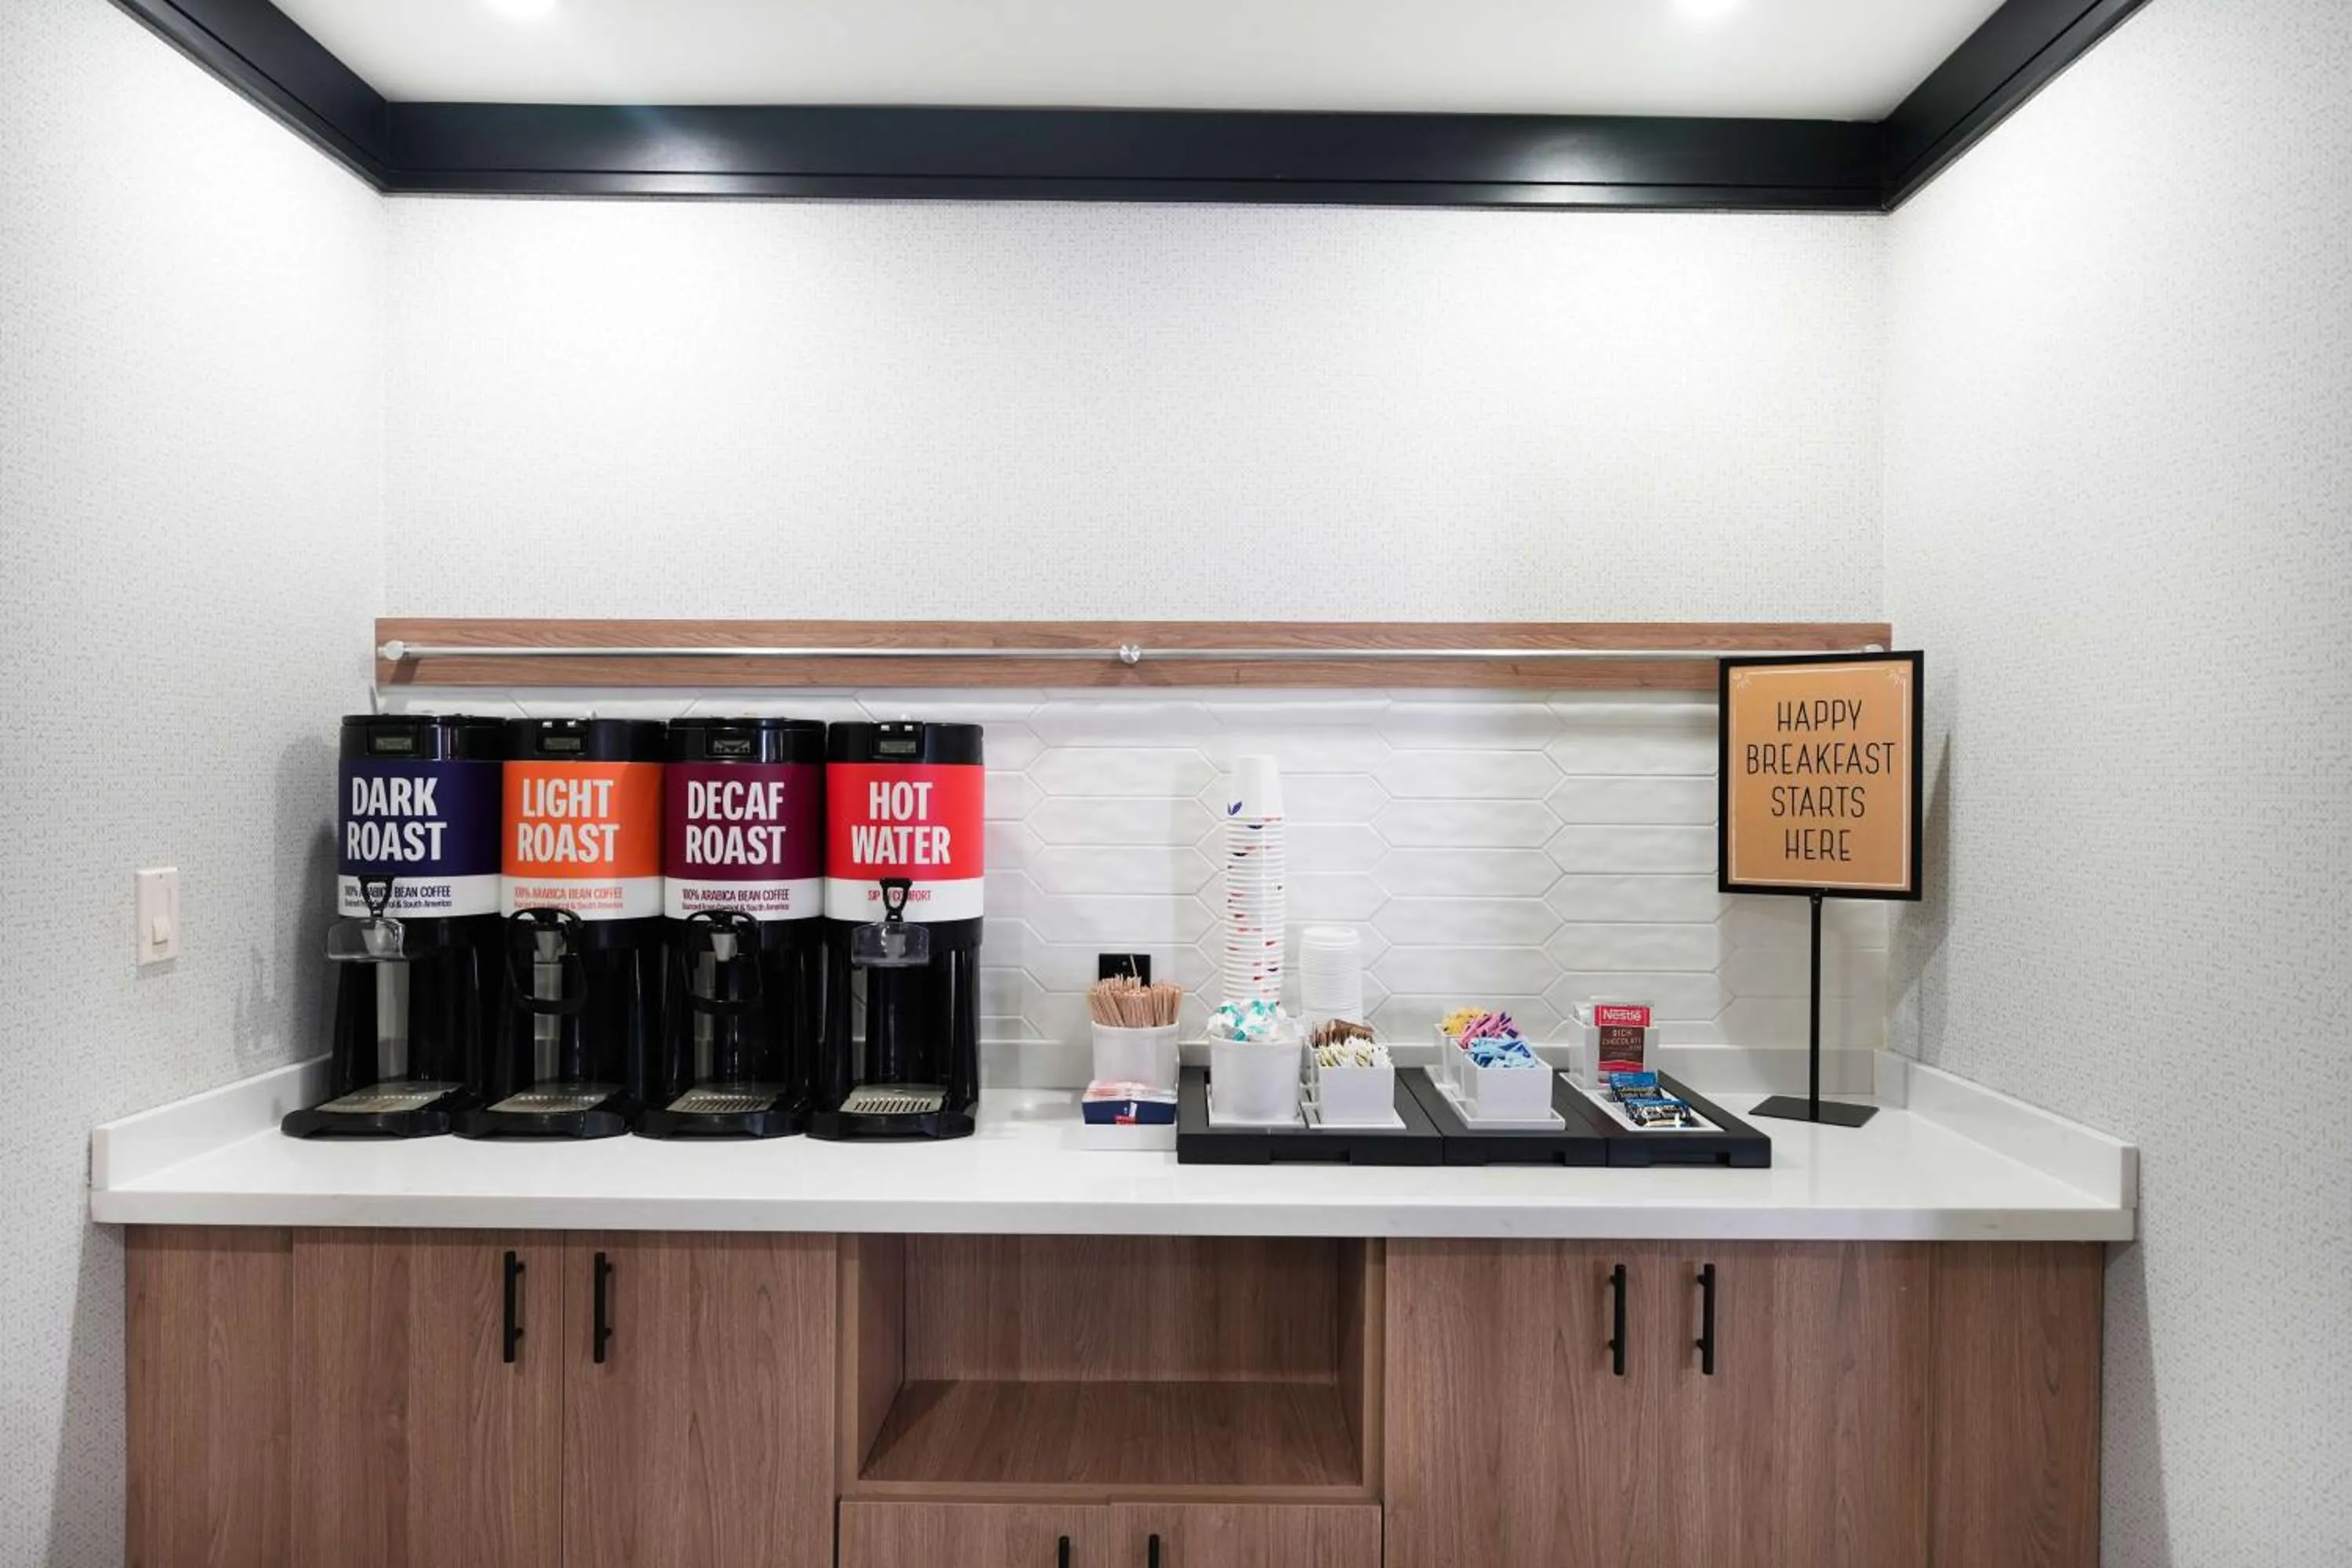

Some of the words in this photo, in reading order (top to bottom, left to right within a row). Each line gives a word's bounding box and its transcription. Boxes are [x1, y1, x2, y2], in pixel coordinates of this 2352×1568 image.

[1777, 699, 1863, 731] HAPPY
[1746, 742, 1896, 775] BREAKFAST
[351, 777, 438, 816] DARK
[522, 778, 614, 818] LIGHT
[688, 780, 785, 821] DECAF
[869, 780, 933, 821] HOT
[1771, 786, 1866, 818] STARTS
[347, 821, 447, 862] ROAST
[517, 822, 620, 862] ROAST
[686, 825, 786, 865] ROAST
[851, 825, 951, 866] WATER
[1785, 828, 1852, 862] HERE
[394, 887, 418, 898] BEAN
[420, 885, 452, 897] COFFEE
[595, 887, 623, 898] COFFEE
[701, 890, 736, 901] ARABICA
[738, 890, 761, 901] BEAN
[763, 888, 789, 901] COFFEE
